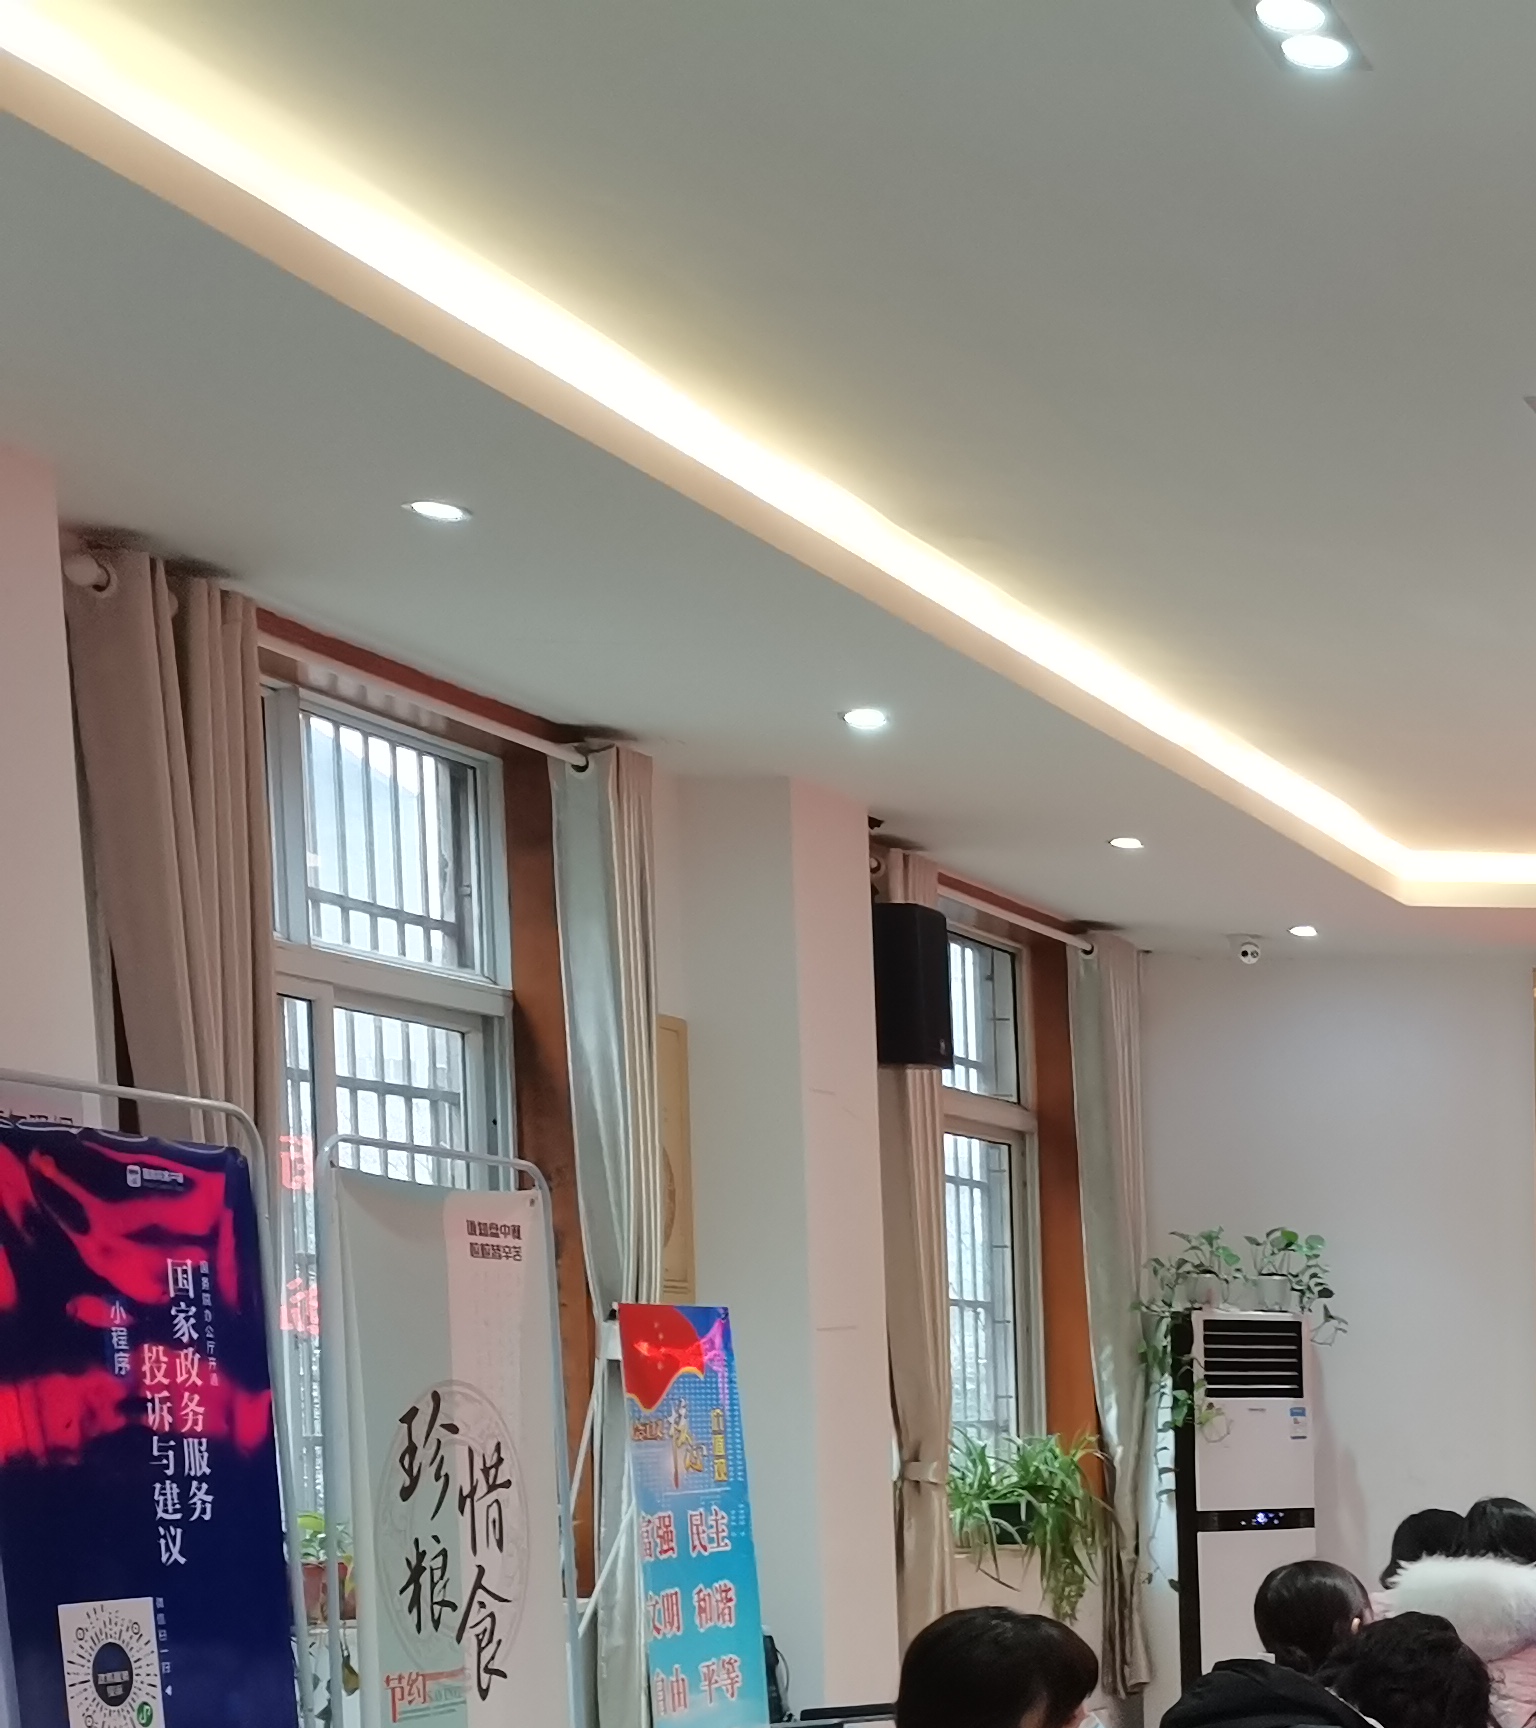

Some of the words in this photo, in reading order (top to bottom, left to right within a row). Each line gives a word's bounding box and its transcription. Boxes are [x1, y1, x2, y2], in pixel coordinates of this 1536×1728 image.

[109, 1299, 132, 1377] 小程序
[166, 1256, 215, 1523] 国家政务服务
[142, 1342, 188, 1568] 投诉与建议
[688, 1507, 731, 1556] 民主
[646, 1588, 682, 1637] 文明
[693, 1580, 736, 1630] 和谐
[653, 1666, 688, 1716] 自由
[699, 1654, 741, 1703] 平等
